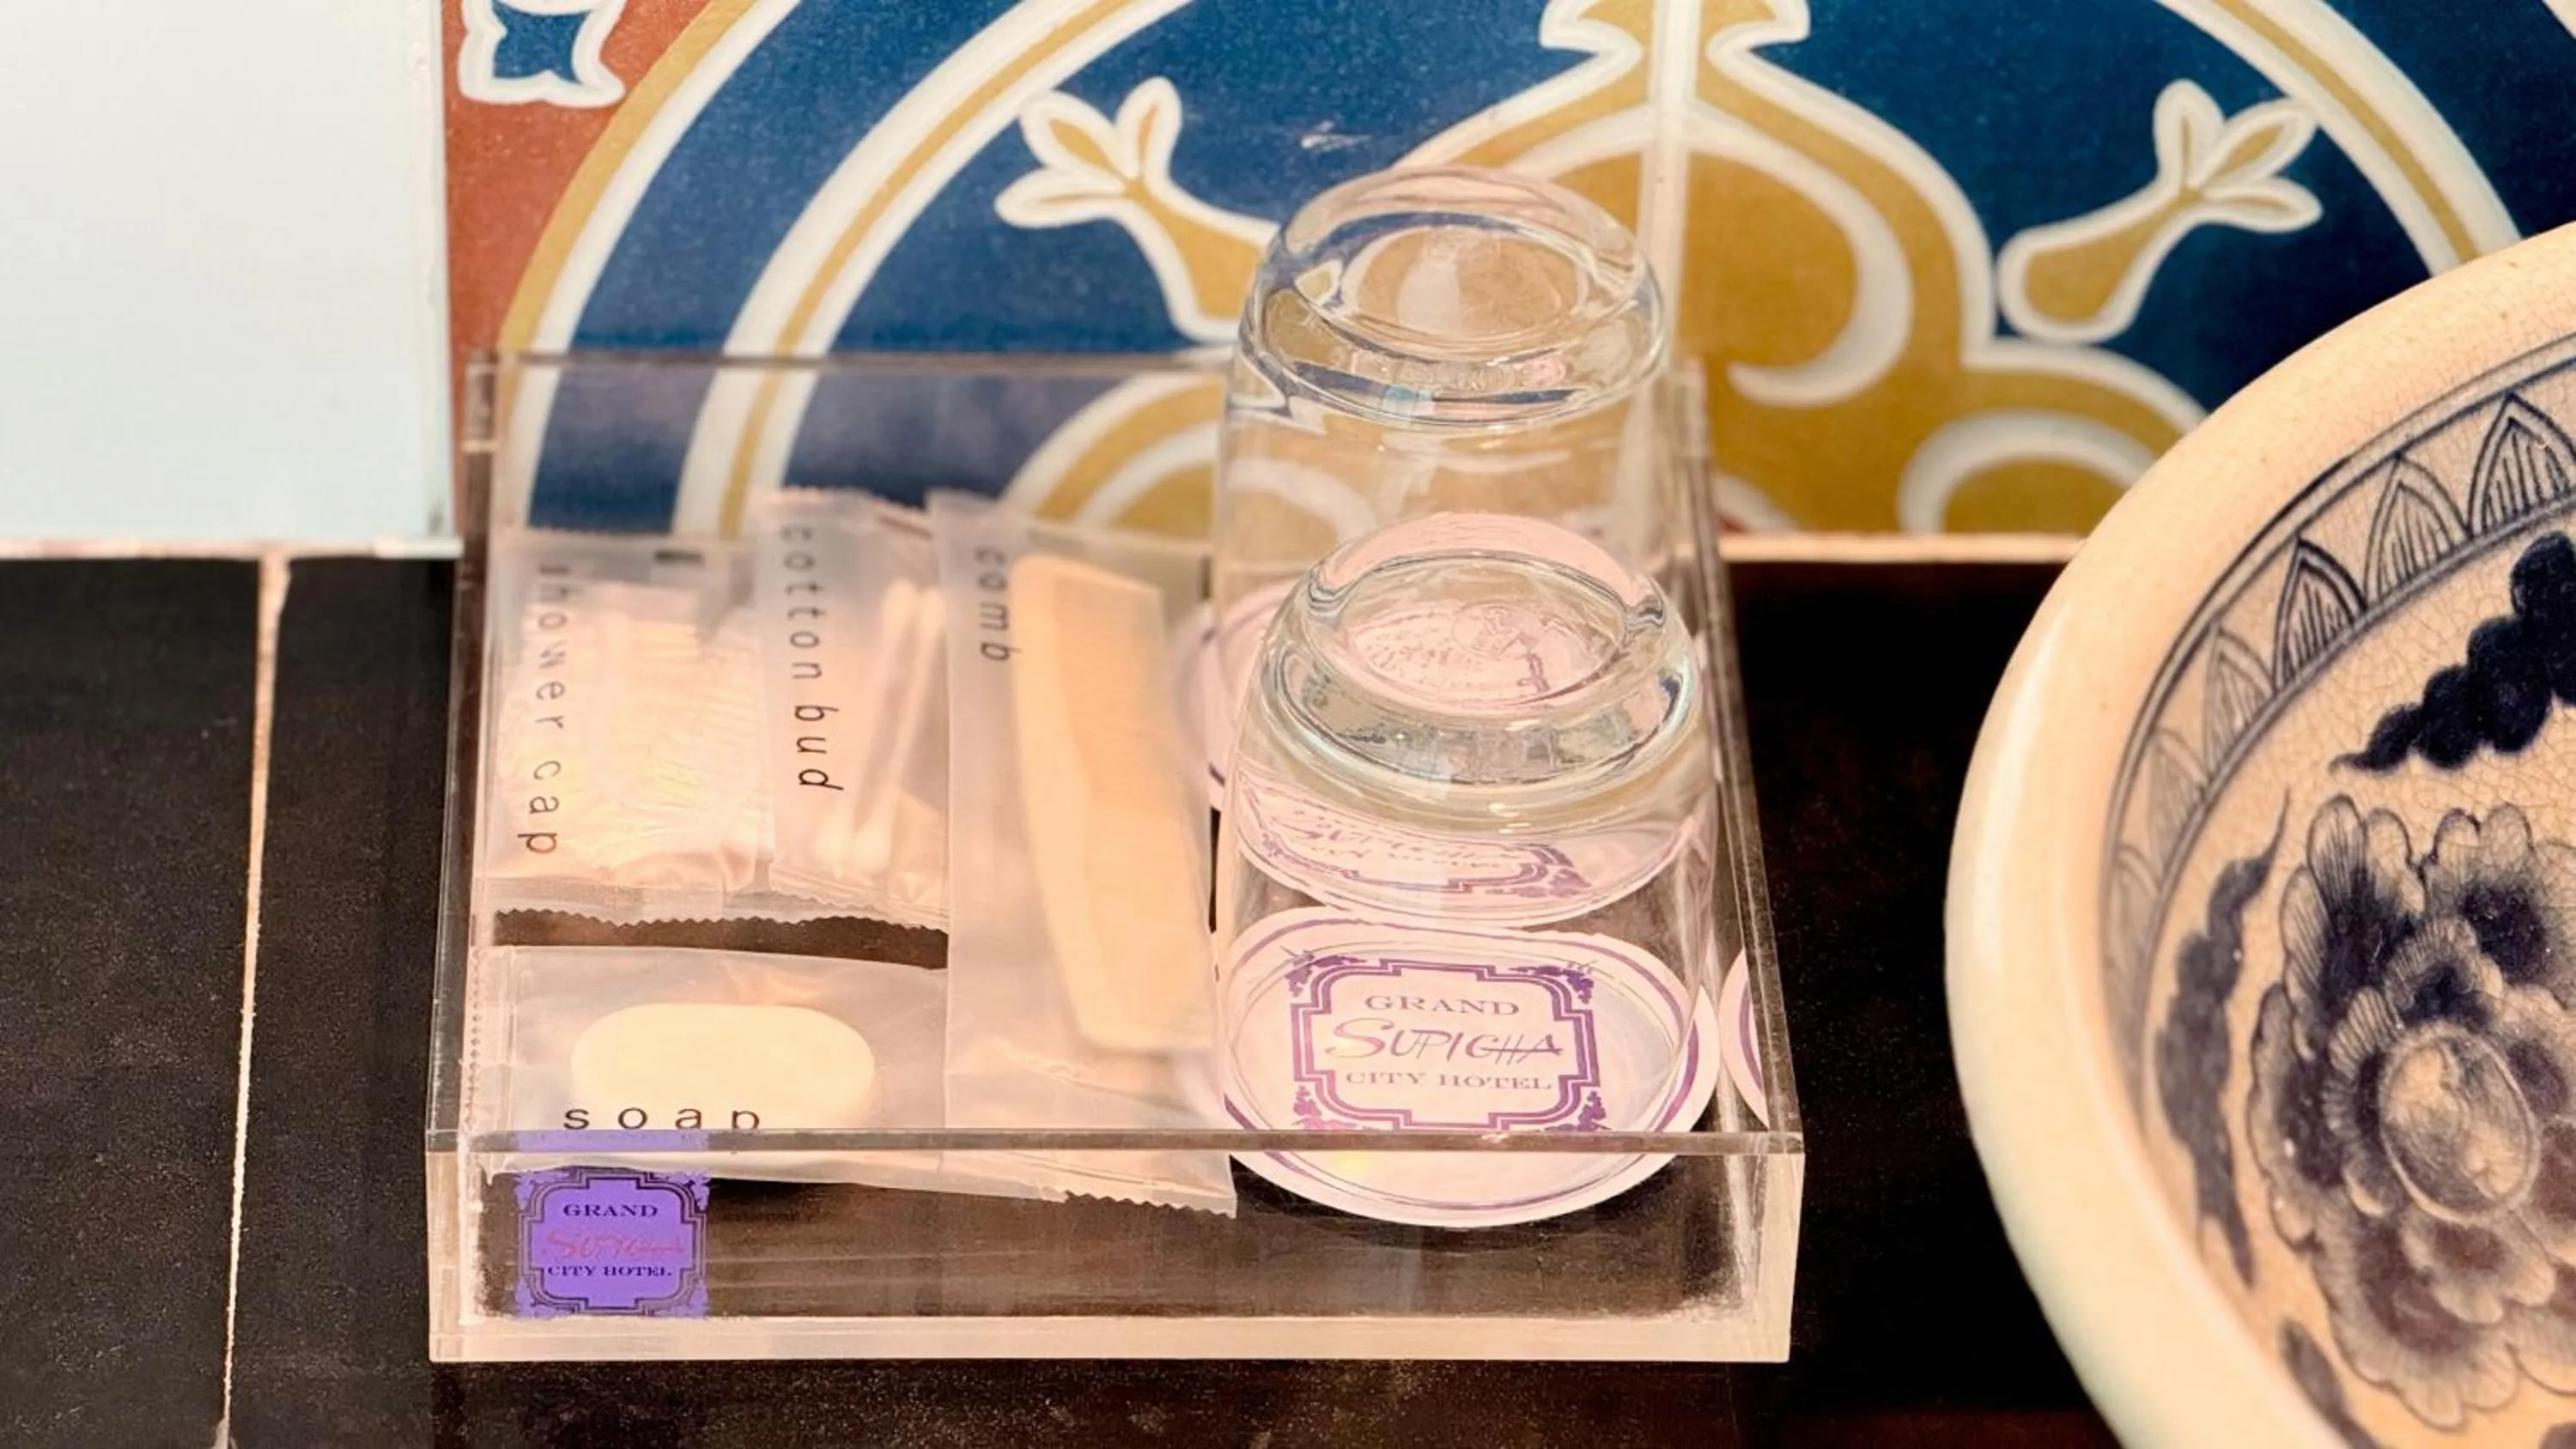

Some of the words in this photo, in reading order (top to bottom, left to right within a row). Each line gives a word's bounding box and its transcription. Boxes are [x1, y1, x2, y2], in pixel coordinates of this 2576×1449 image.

[779, 524, 828, 681] cotton
[974, 545, 1024, 660] comb
[533, 563, 584, 730] shower
[793, 704, 845, 791] bud
[516, 760, 562, 854] cap
[1364, 994, 1520, 1016] GRAND
[1345, 1071, 1426, 1085] CITY
[1437, 1073, 1552, 1090] HOTEL
[562, 1106, 761, 1131] soap
[562, 1203, 659, 1217] GRAND
[547, 1264, 597, 1276] CITY
[603, 1265, 673, 1277] HOTEL
